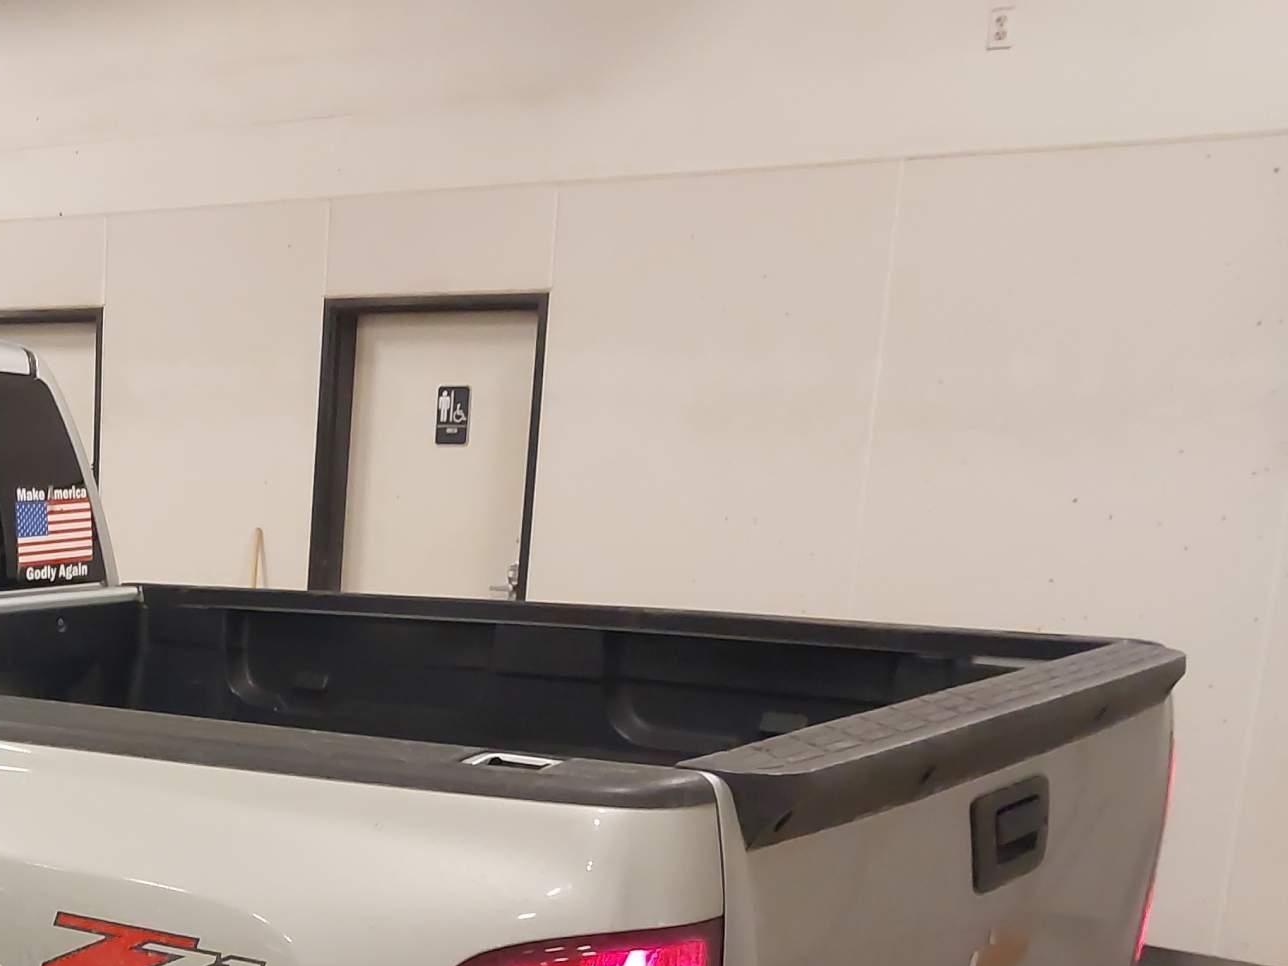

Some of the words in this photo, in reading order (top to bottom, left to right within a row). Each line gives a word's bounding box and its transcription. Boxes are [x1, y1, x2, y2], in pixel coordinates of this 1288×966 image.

[16, 487, 45, 501] Make
[26, 565, 57, 582] Godly
[59, 562, 88, 580] Again
